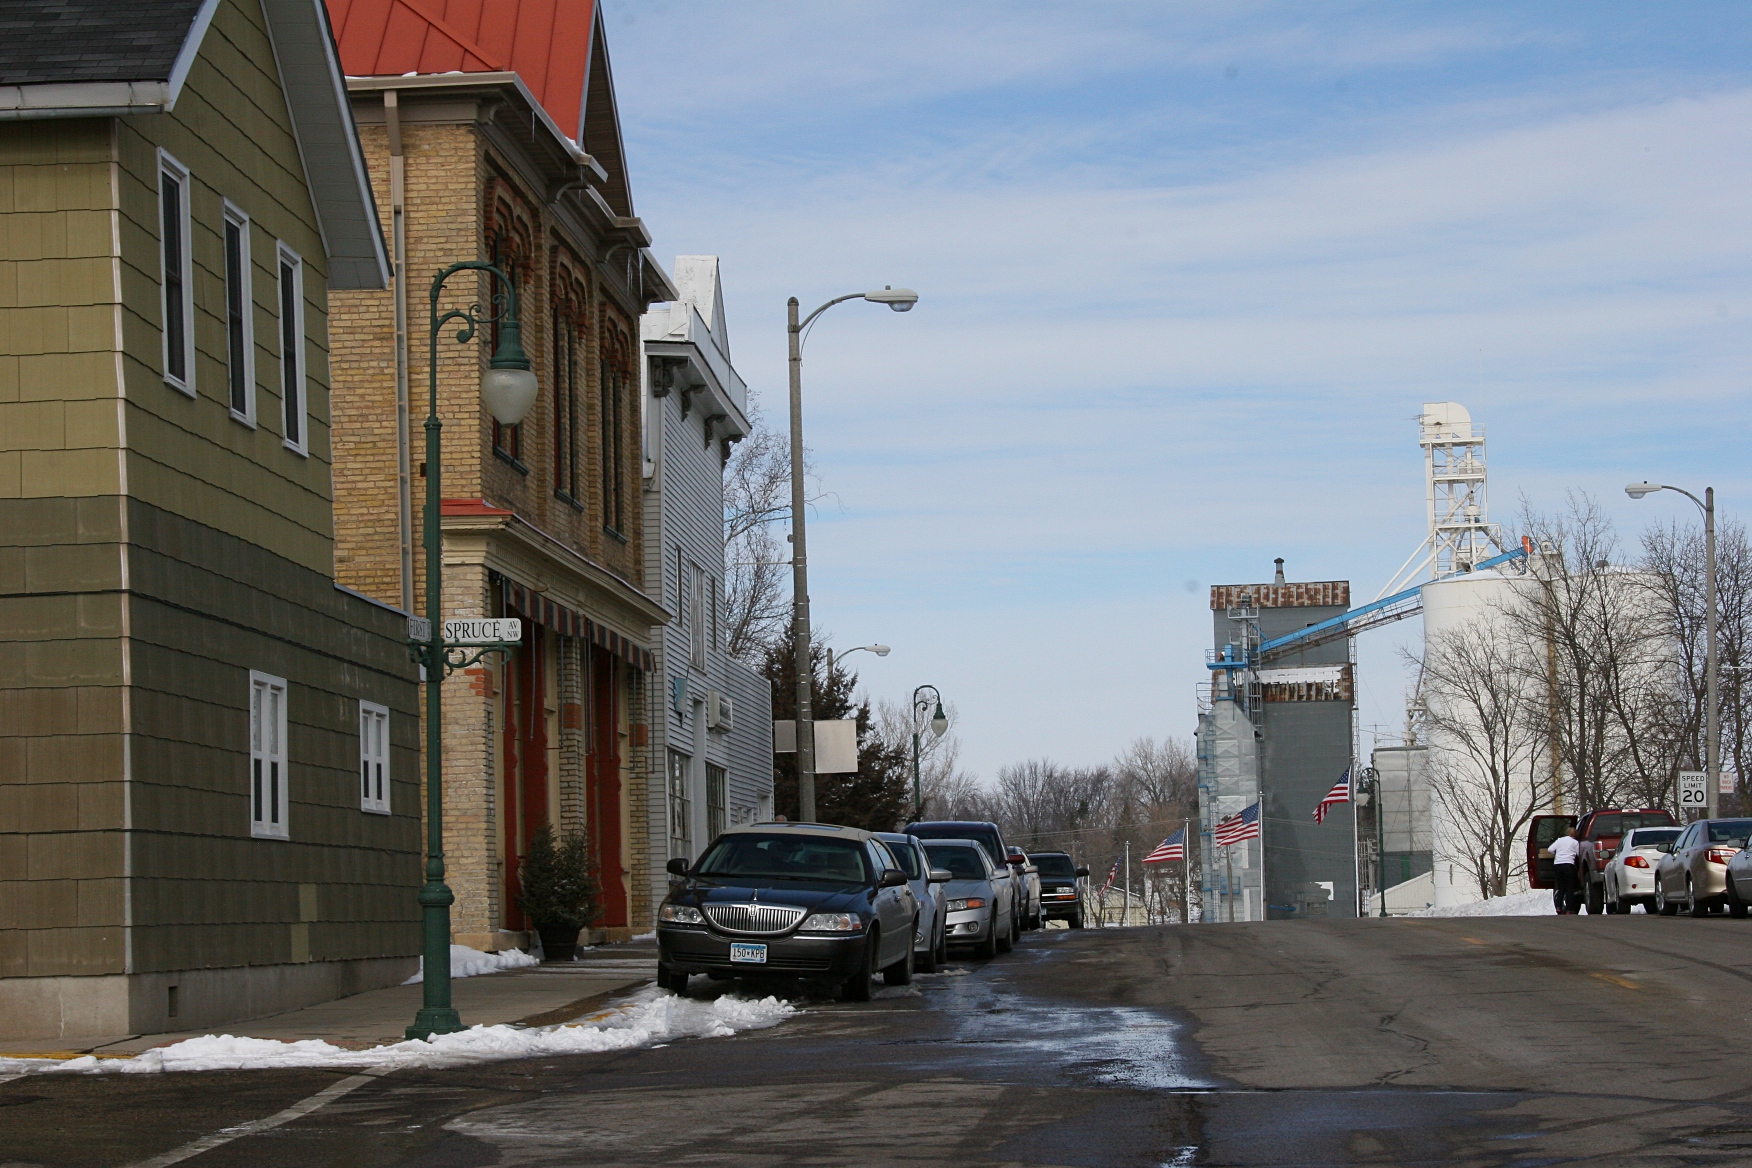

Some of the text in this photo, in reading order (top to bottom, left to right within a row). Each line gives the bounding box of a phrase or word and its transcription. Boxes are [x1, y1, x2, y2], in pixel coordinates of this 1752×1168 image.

[410, 618, 426, 637] FIRST
[445, 621, 501, 639] SPRUCE
[508, 621, 519, 629] AV
[1682, 790, 1704, 802] 20
